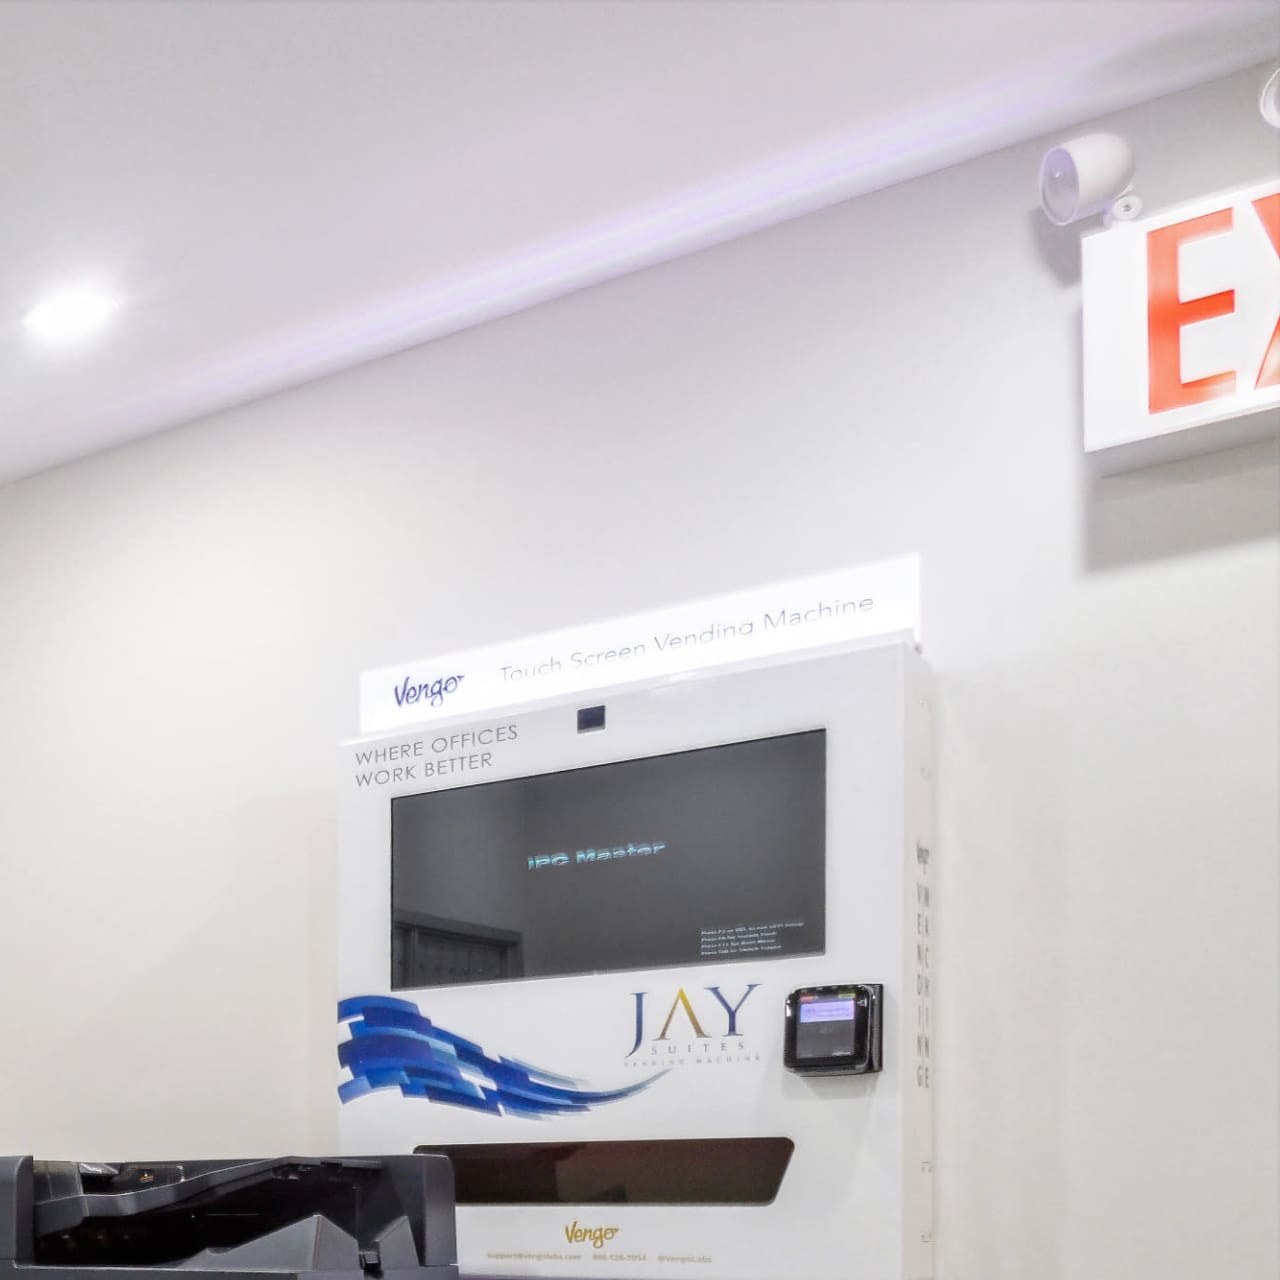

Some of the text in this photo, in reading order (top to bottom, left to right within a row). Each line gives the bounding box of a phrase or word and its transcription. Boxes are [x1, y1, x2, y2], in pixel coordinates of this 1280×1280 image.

[1146, 192, 1280, 415] E
[394, 595, 875, 708] Vengo Touch Screen Vending Machine
[355, 724, 519, 766] WHERE OFFICES
[355, 751, 493, 788] WORK BETTER
[528, 840, 667, 871] IPC Master
[624, 983, 764, 1058] JAY
[650, 1041, 745, 1056] SUITES
[565, 1220, 619, 1248] Vengo
